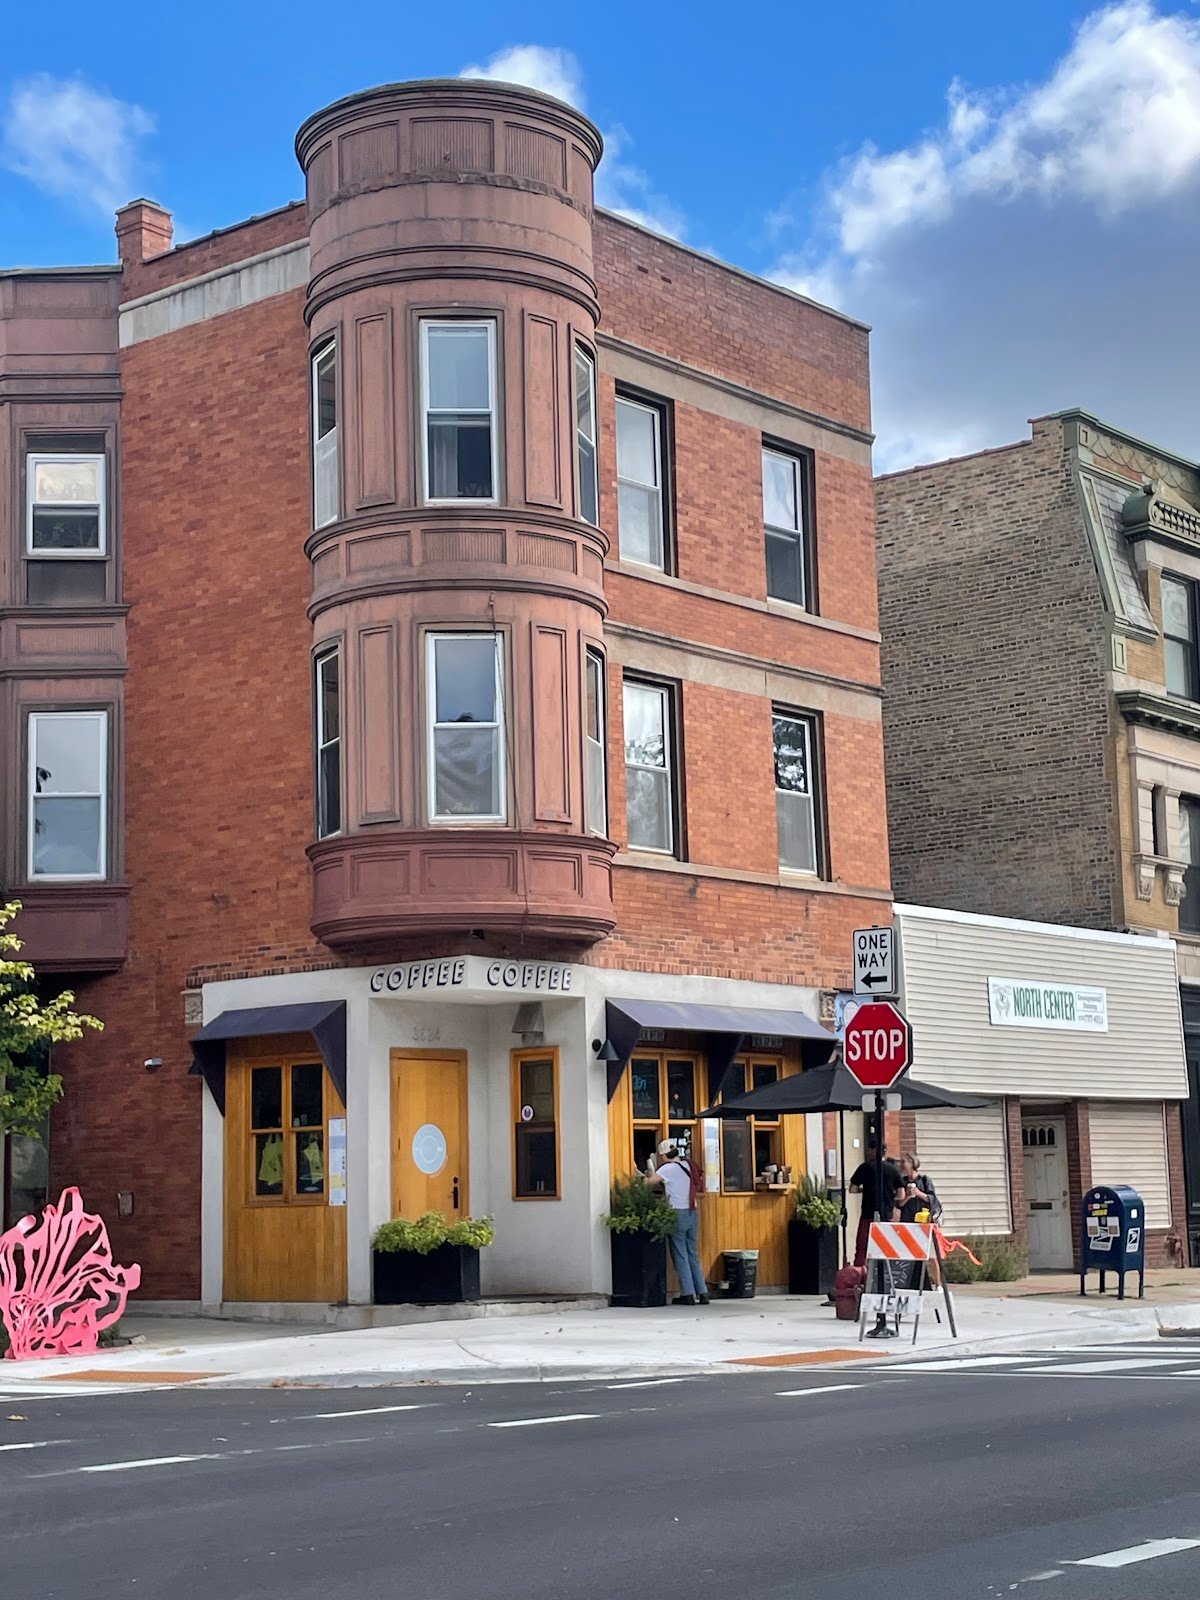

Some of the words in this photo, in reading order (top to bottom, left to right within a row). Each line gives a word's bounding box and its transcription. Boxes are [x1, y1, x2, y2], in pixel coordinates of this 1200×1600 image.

[858, 934, 888, 950] ONE
[858, 952, 888, 968] WAY
[371, 960, 465, 992] COFFEE
[487, 961, 573, 991] COFFEE
[1012, 986, 1042, 1017] NORTH
[1043, 990, 1075, 1021] CENTER
[848, 1029, 903, 1061] STOP
